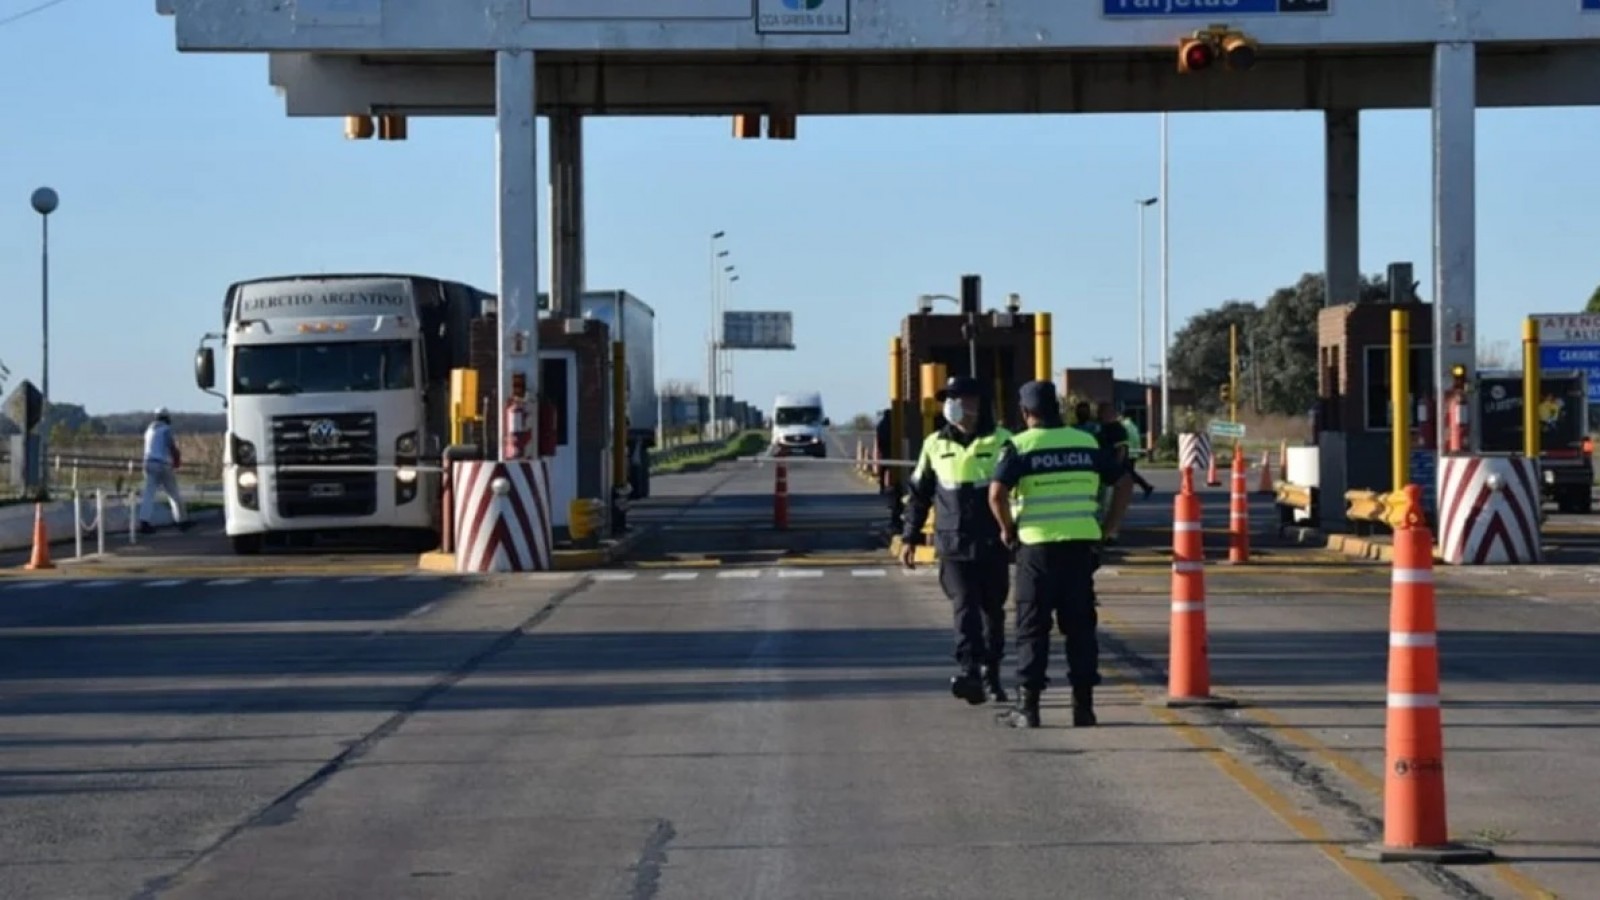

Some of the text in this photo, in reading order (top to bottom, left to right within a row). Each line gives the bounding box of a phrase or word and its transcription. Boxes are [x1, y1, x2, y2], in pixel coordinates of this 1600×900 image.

[244, 291, 404, 311] EJERCITO ARGENTINO
[1031, 452, 1094, 470] POLICIA
